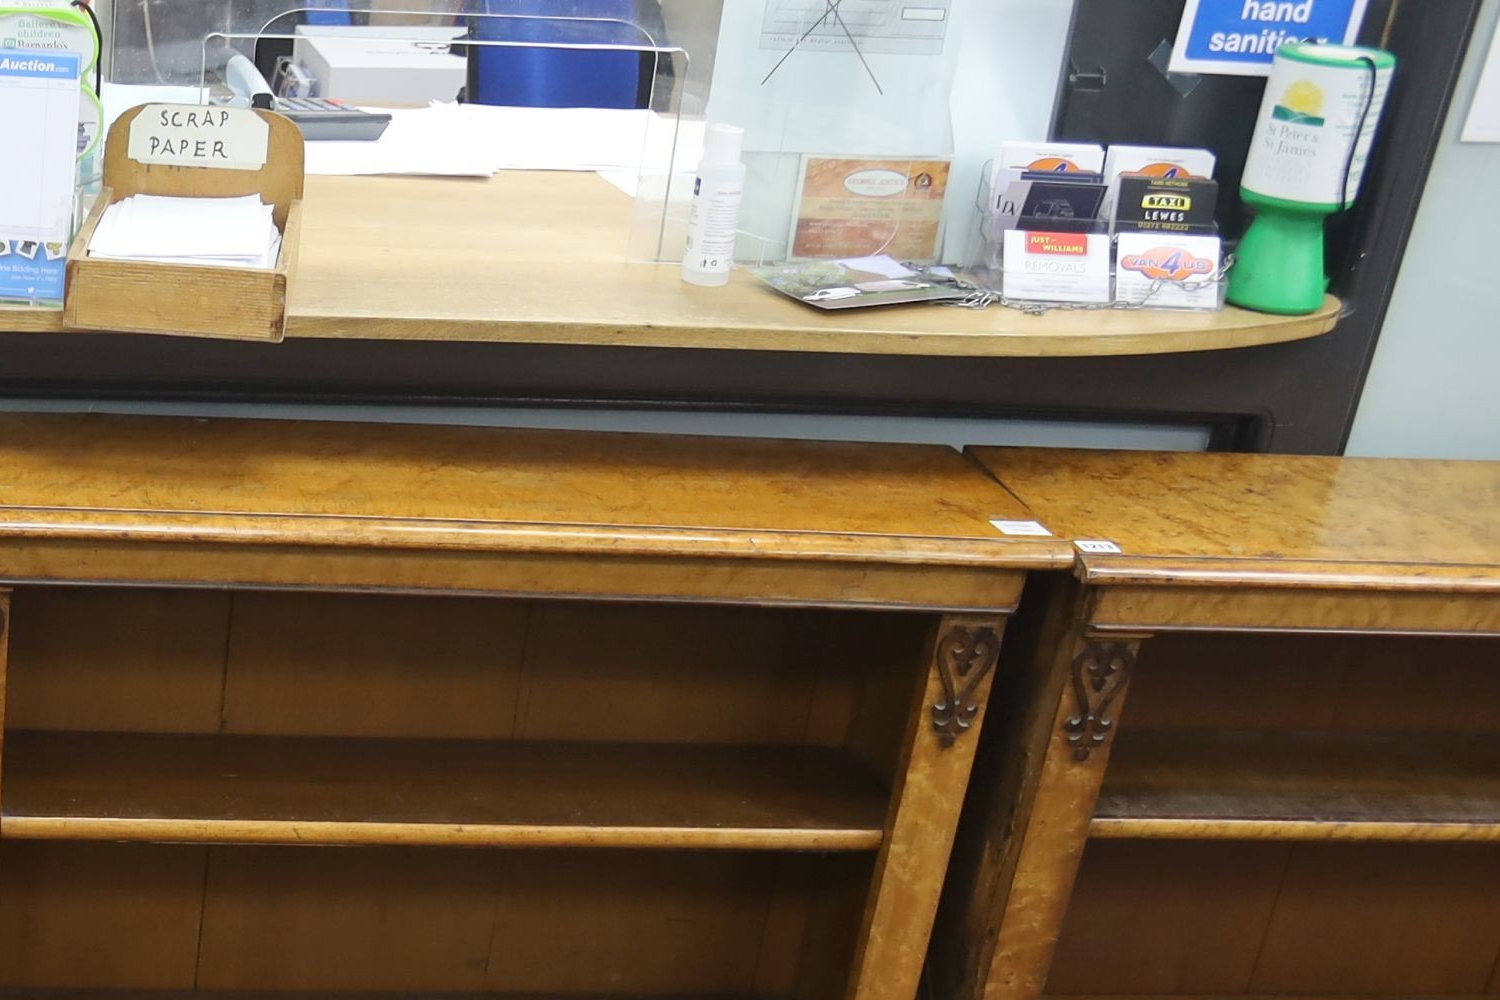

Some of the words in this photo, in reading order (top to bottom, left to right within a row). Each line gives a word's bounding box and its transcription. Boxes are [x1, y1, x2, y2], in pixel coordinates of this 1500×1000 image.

[1241, 0, 1313, 23] hand
[17, 29, 61, 38] children
[1208, 29, 1328, 54] saniti
[160, 109, 229, 128] SCRAP
[1279, 125, 1310, 142] Peter
[149, 136, 228, 158] PAPER
[1274, 139, 1317, 157] James
[1153, 197, 1181, 208] TAXI
[1144, 211, 1185, 222] LEWES
[1030, 236, 1050, 244] JUST
[1042, 244, 1084, 253] WILLIAMS
[12, 264, 40, 274] Bidding
[40, 266, 58, 275] Here
[1025, 260, 1086, 274] REMOVALS
[1129, 258, 1160, 267] VAN
[1160, 251, 1182, 275] 4
[1183, 261, 1207, 271] US
